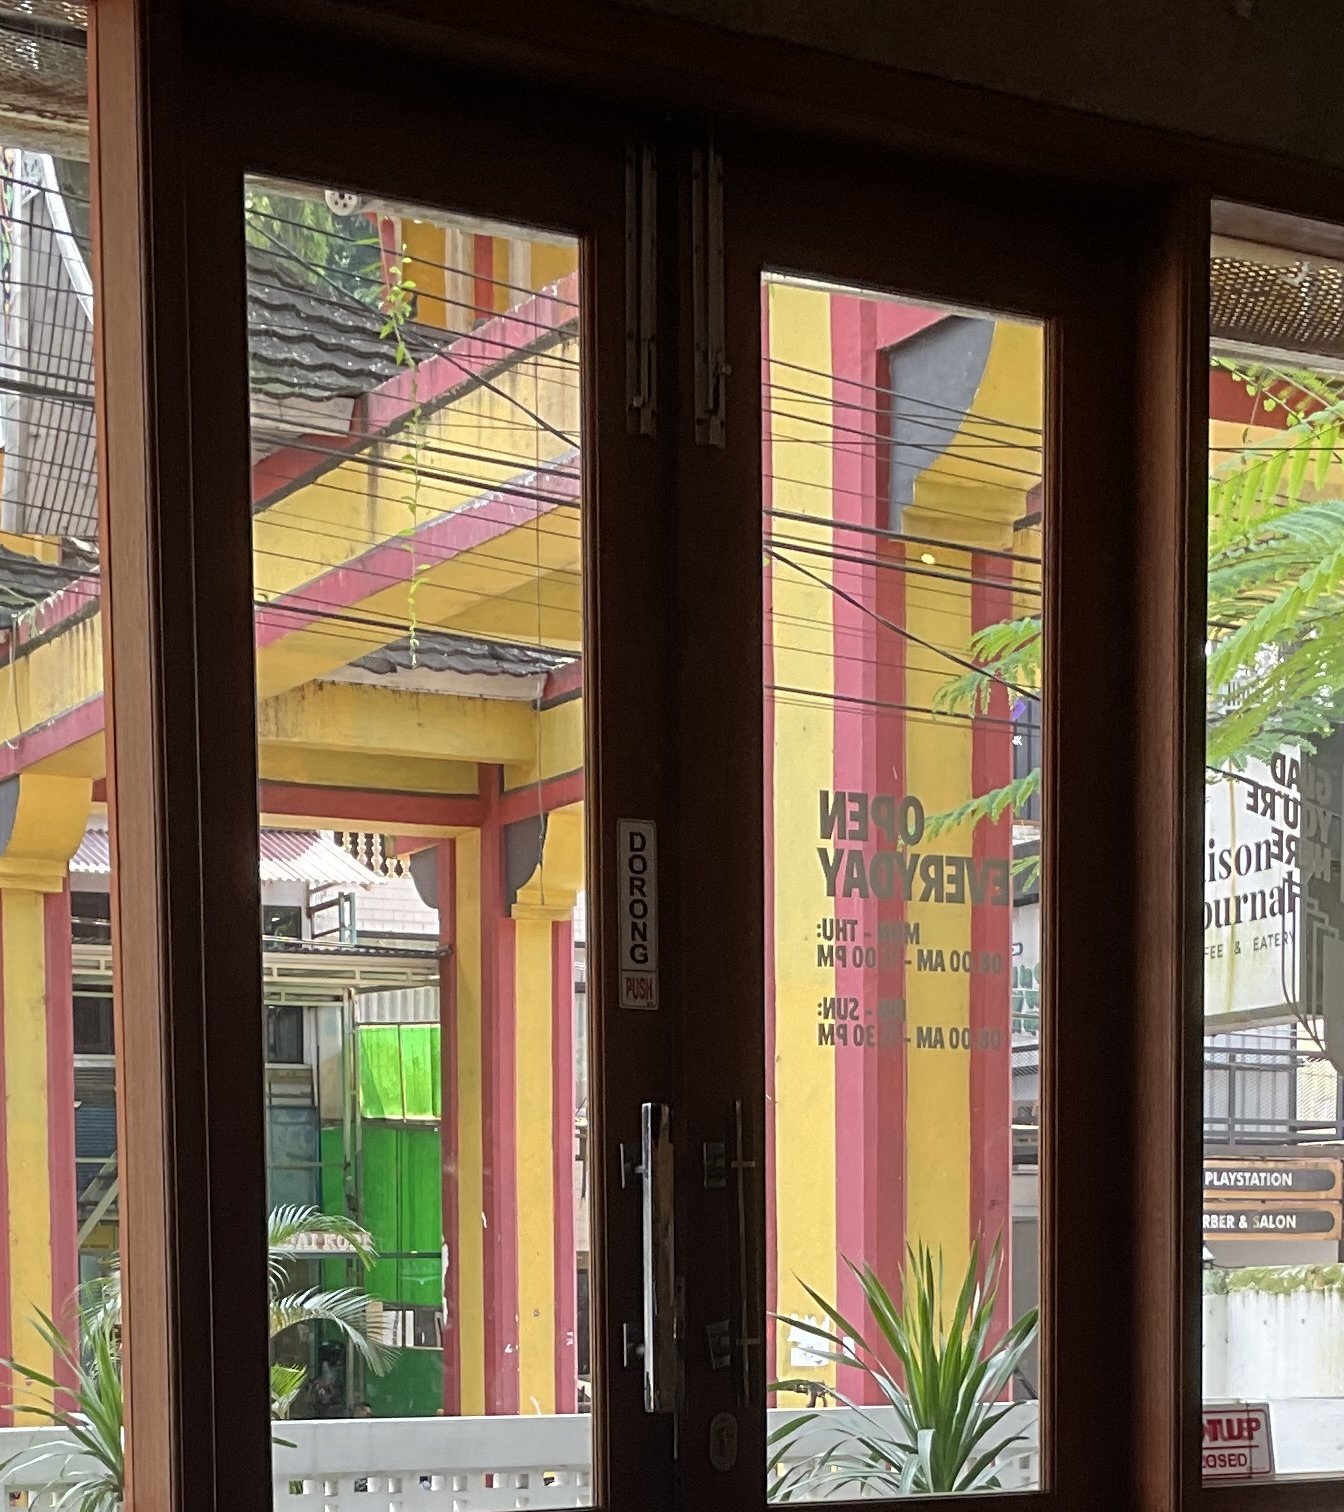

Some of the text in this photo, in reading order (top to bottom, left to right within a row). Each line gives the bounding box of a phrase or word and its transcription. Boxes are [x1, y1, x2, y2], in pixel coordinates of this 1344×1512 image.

[1205, 838, 1272, 882] ison
[628, 831, 649, 965] DORONG
[626, 977, 653, 1000] PUSH
[1204, 1171, 1293, 1187] PLAYSTATION
[1238, 1214, 1248, 1229] &
[1252, 1214, 1296, 1229] SALON
[1205, 1417, 1261, 1441] TUP
